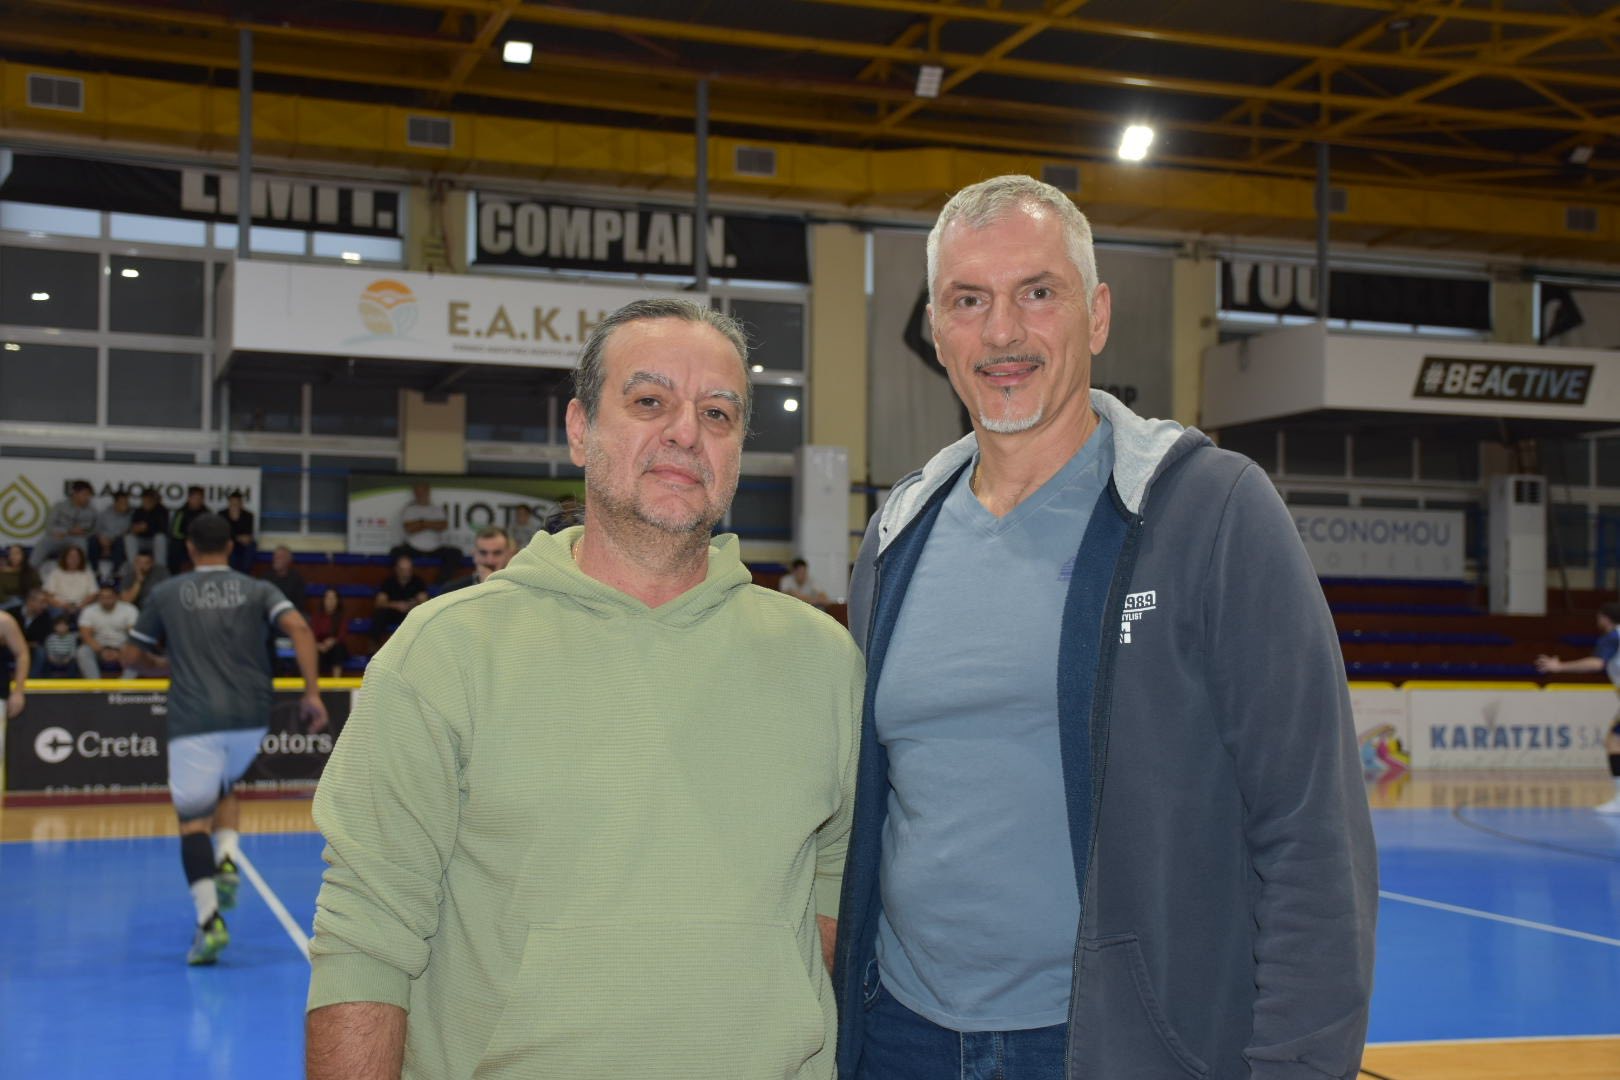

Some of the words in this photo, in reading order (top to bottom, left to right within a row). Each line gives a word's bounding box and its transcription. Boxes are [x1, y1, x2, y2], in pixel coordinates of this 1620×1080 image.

[479, 201, 737, 269] COMPLAIN.
[1423, 362, 1587, 399] #BEACTIVE
[1295, 515, 1451, 548] ECONOMOU
[76, 730, 160, 758] Creta
[257, 730, 333, 755] otors
[1430, 724, 1572, 750] KARATZIS
